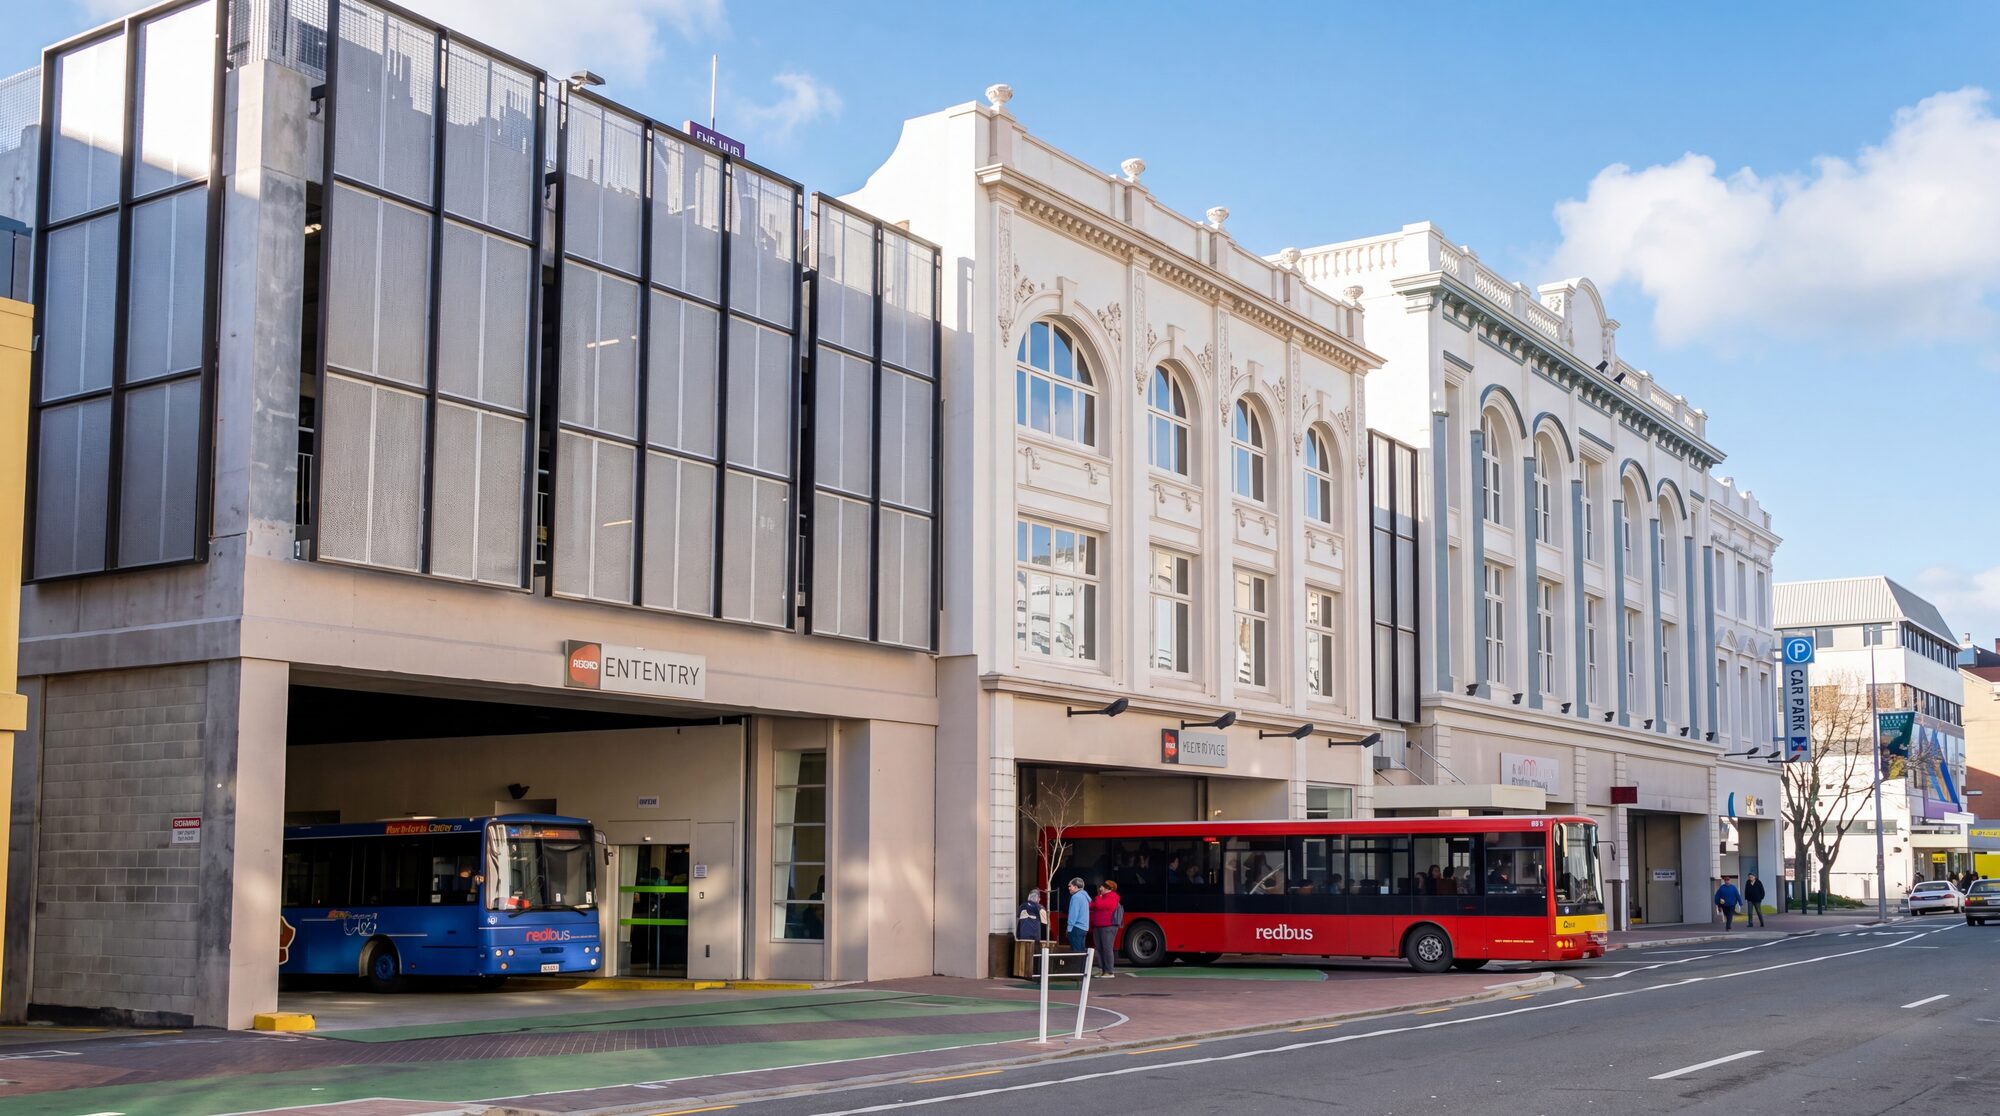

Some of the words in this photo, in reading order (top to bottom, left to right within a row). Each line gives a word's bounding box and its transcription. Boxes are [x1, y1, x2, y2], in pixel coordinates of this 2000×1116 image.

[1794, 643, 1806, 660] P
[605, 656, 700, 686] ENTENTRY
[1790, 669, 1804, 695] CAR
[1791, 698, 1806, 732] PARK
[1255, 924, 1314, 941] redbus
